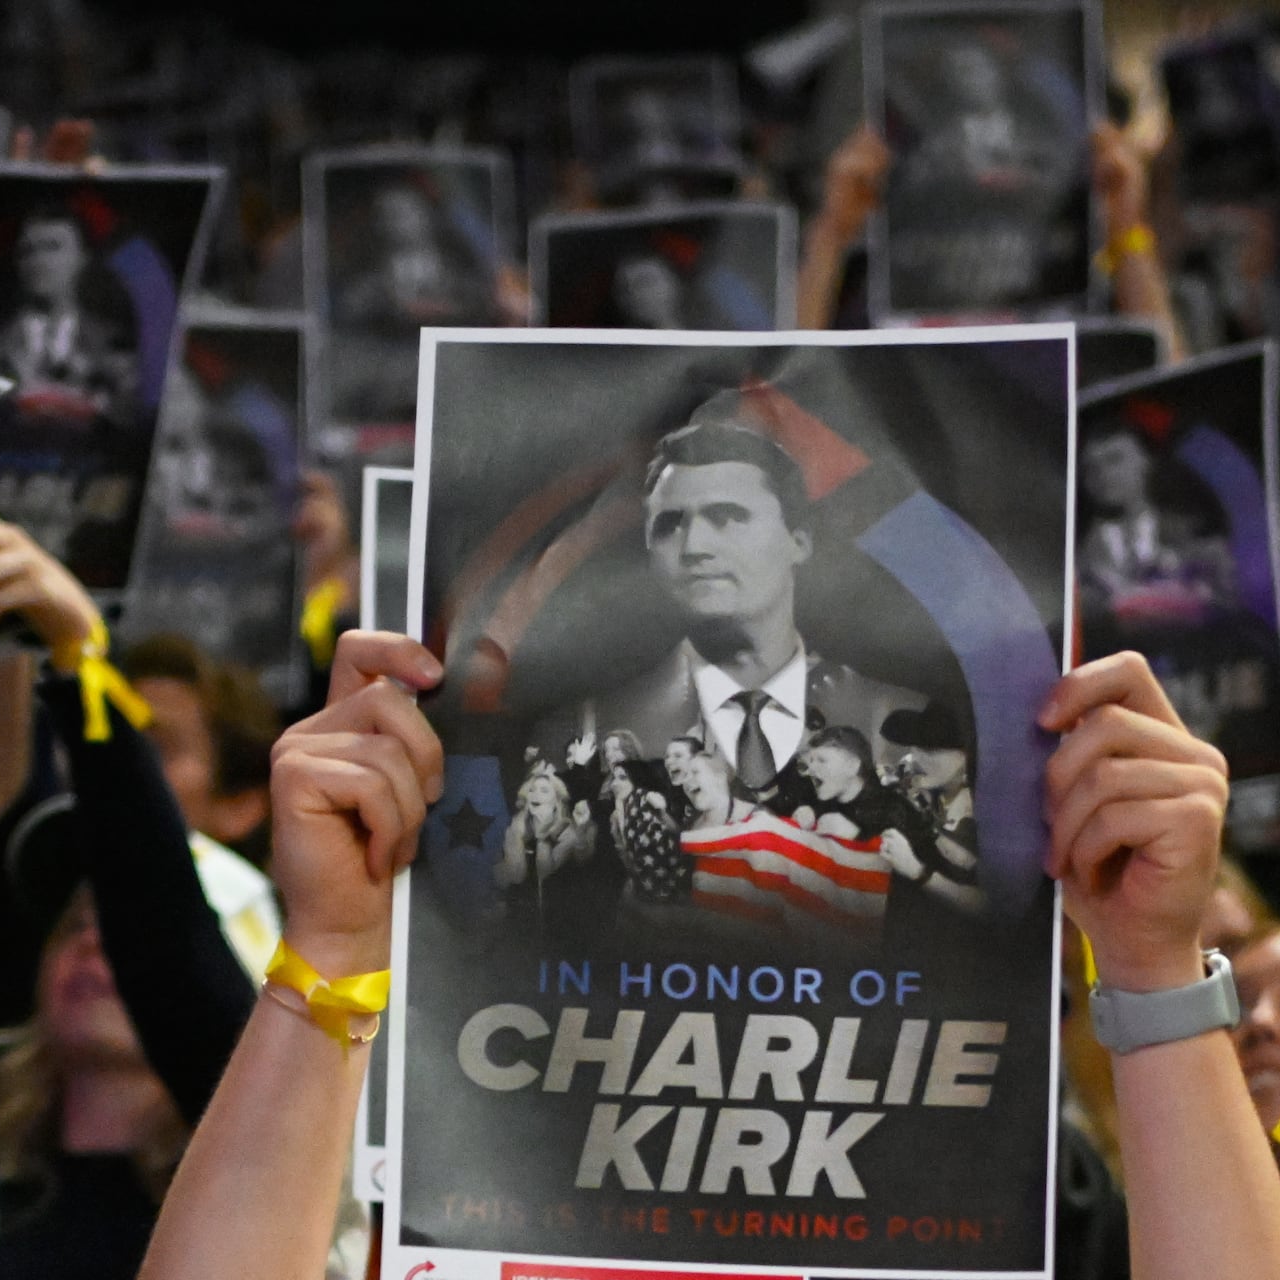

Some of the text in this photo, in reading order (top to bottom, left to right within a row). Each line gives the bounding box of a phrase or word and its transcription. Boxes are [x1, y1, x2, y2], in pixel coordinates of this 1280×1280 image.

[538, 959, 923, 1006] IN HONOR OF
[456, 1002, 1010, 1108] CHARLIE
[573, 1103, 888, 1200] KIRK
[689, 1207, 872, 1244] TURNING
